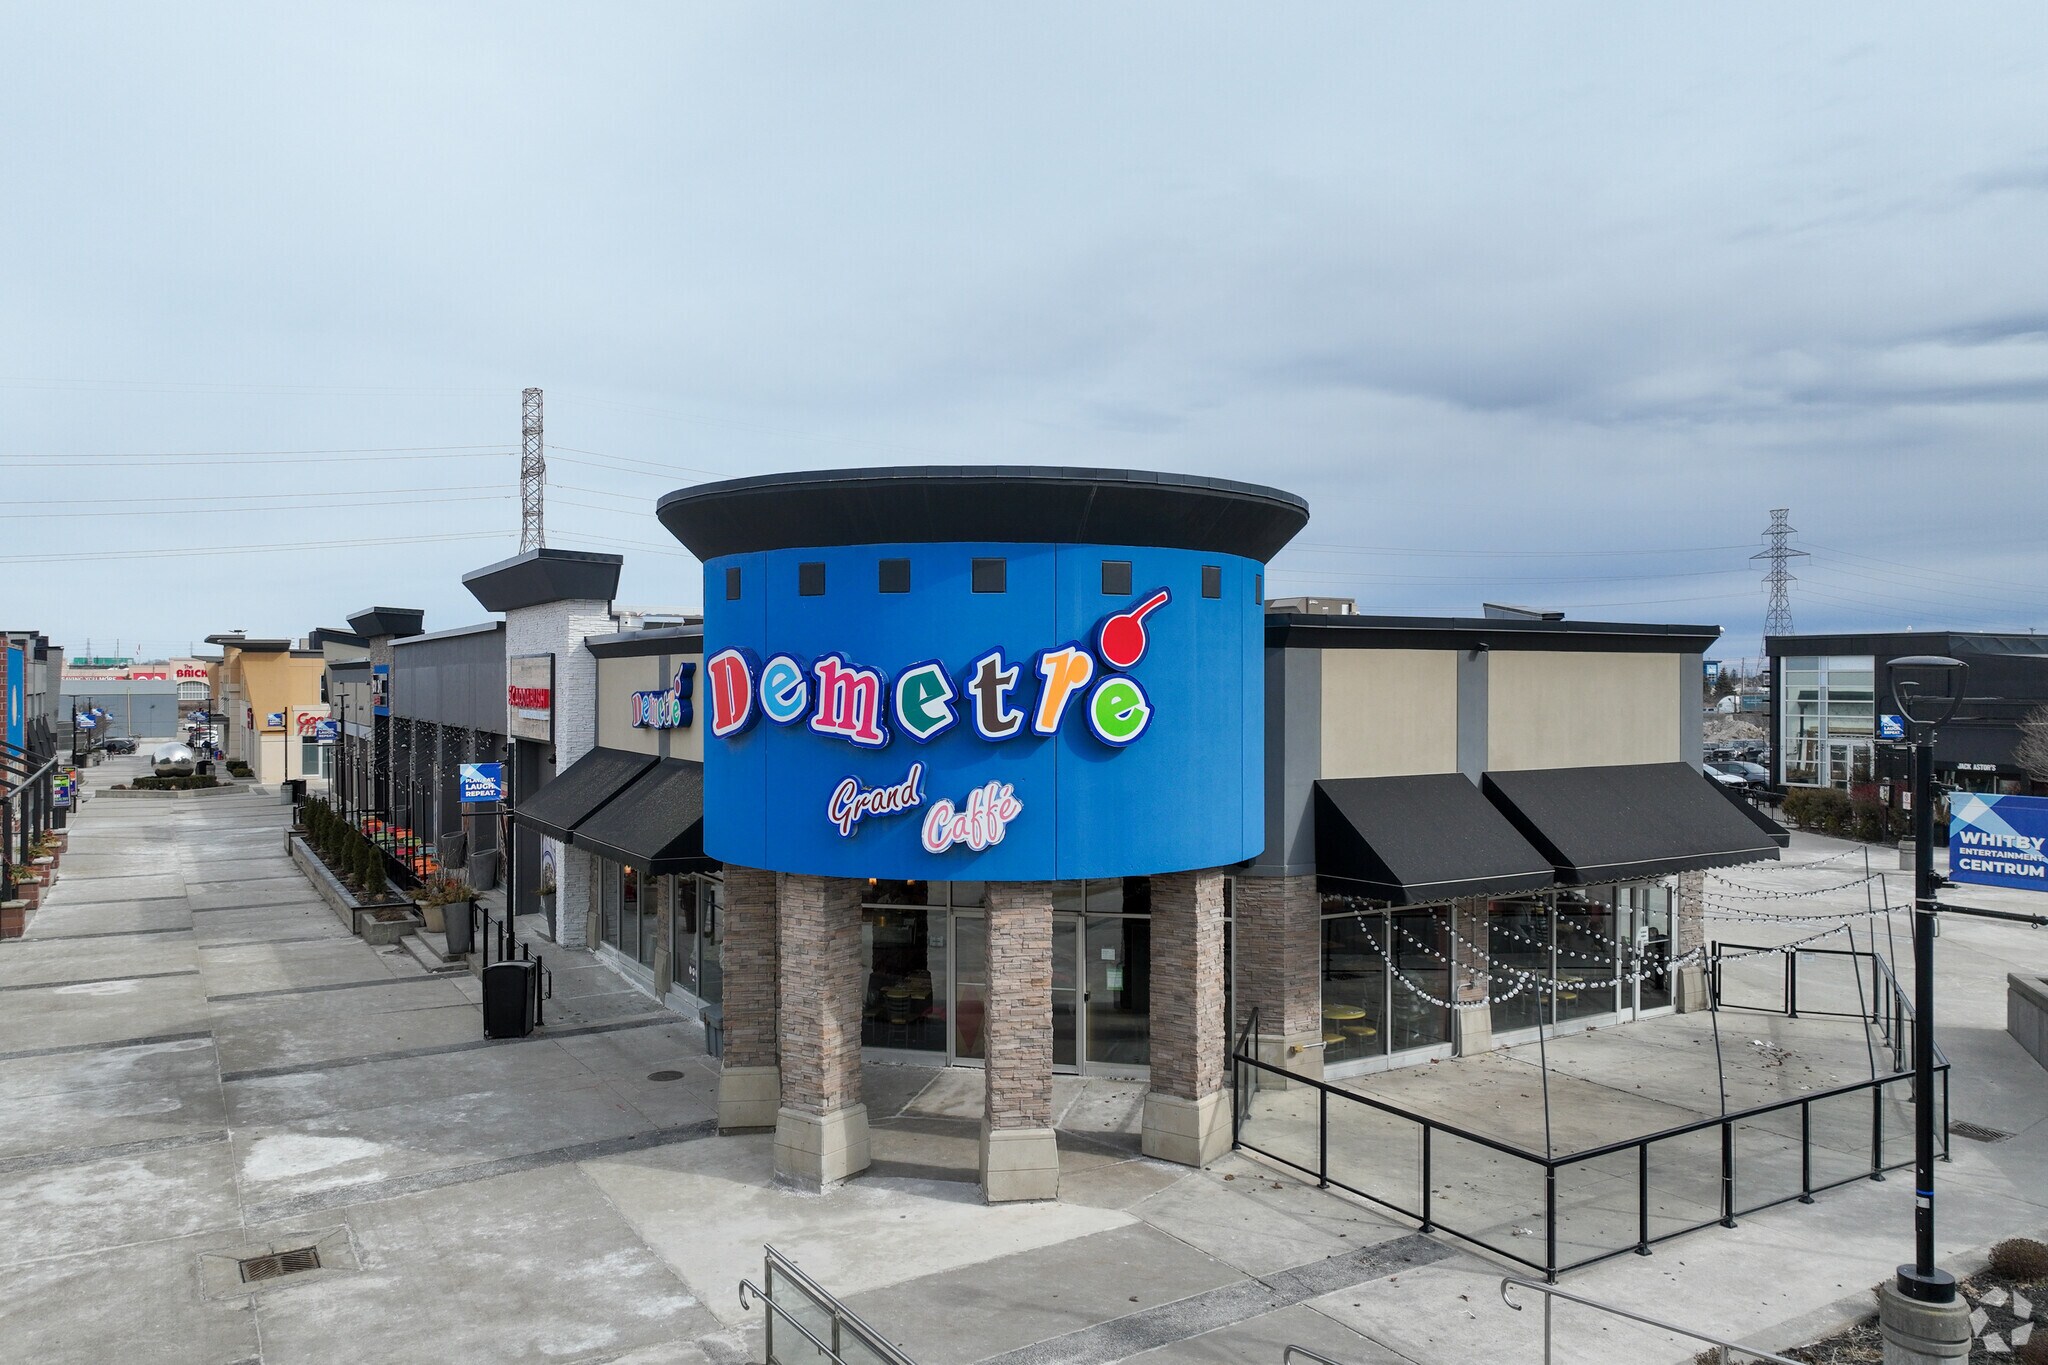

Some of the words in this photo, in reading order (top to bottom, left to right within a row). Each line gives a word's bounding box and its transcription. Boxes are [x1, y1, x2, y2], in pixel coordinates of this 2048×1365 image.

[176, 669, 208, 678] BRICK
[465, 790, 497, 798] REPEAT.
[830, 763, 922, 836] Grand
[924, 780, 1020, 851] Caffé
[1959, 830, 2046, 851] WHITBY
[1959, 847, 2045, 862] ENTERTAINMENT
[1959, 858, 2045, 878] CENTRUM
